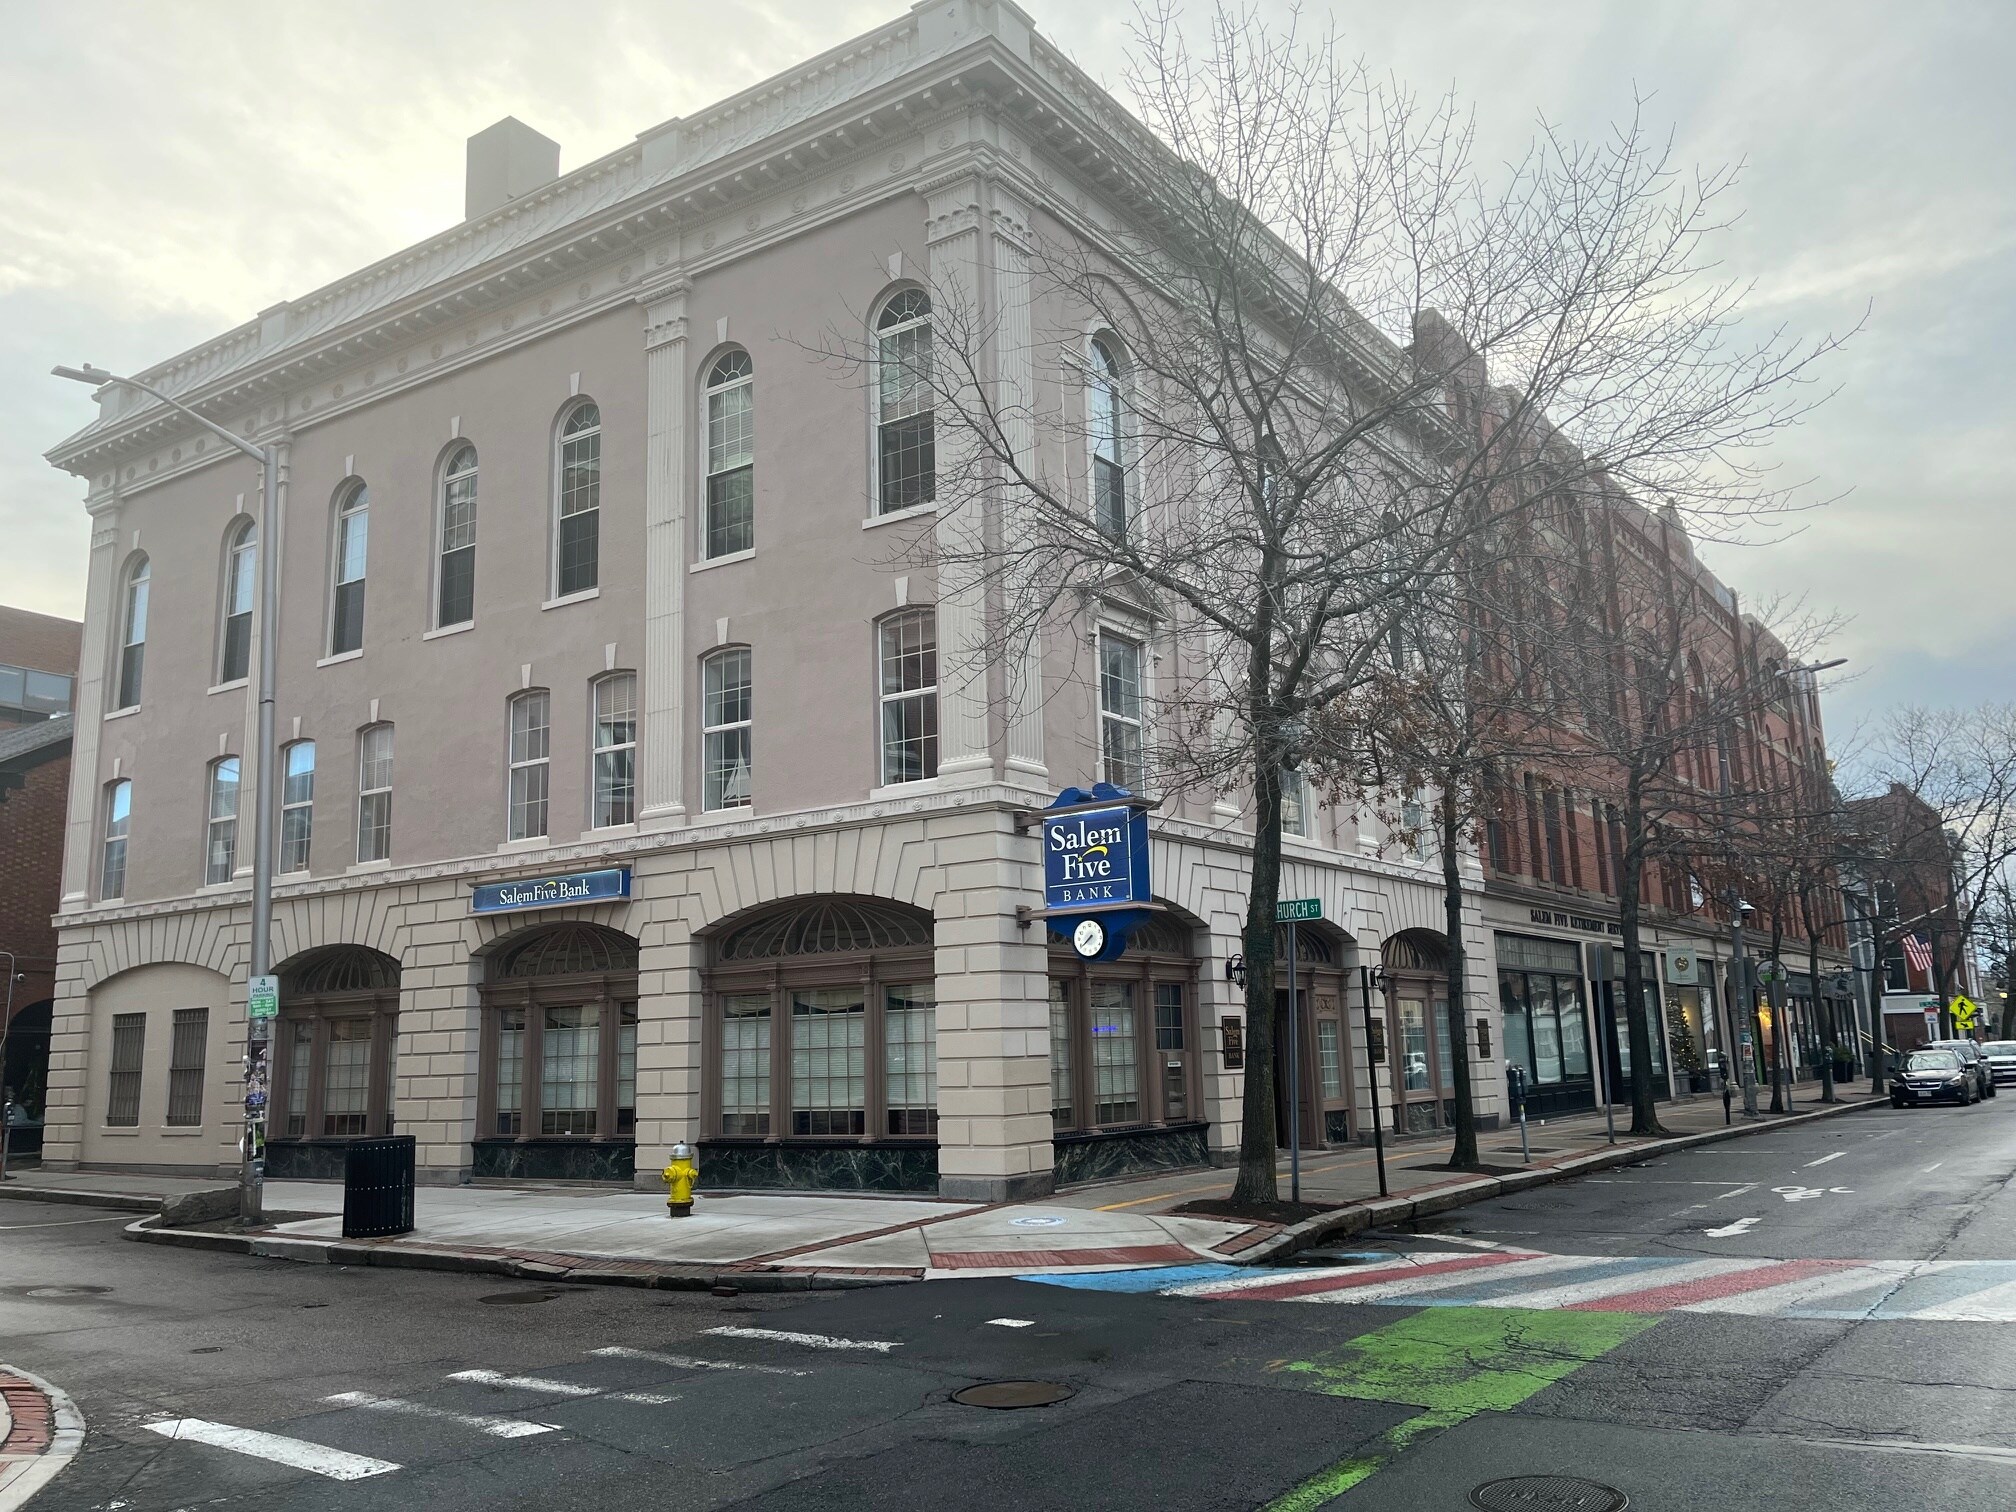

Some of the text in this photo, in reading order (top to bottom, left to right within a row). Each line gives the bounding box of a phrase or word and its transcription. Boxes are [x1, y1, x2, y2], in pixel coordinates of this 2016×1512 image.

[1050, 820, 1122, 852] Salem
[1062, 853, 1111, 880] Five
[559, 879, 590, 898] Bank
[1063, 885, 1113, 902] BANK
[1276, 901, 1319, 919] HURCH ST
[1530, 909, 1552, 924] SALEM
[1554, 912, 1568, 927] FIVE
[252, 986, 274, 994] HOUR
[260, 978, 266, 986] 4
[1225, 1026, 1240, 1036] Salem
[1228, 1036, 1239, 1046] Five
